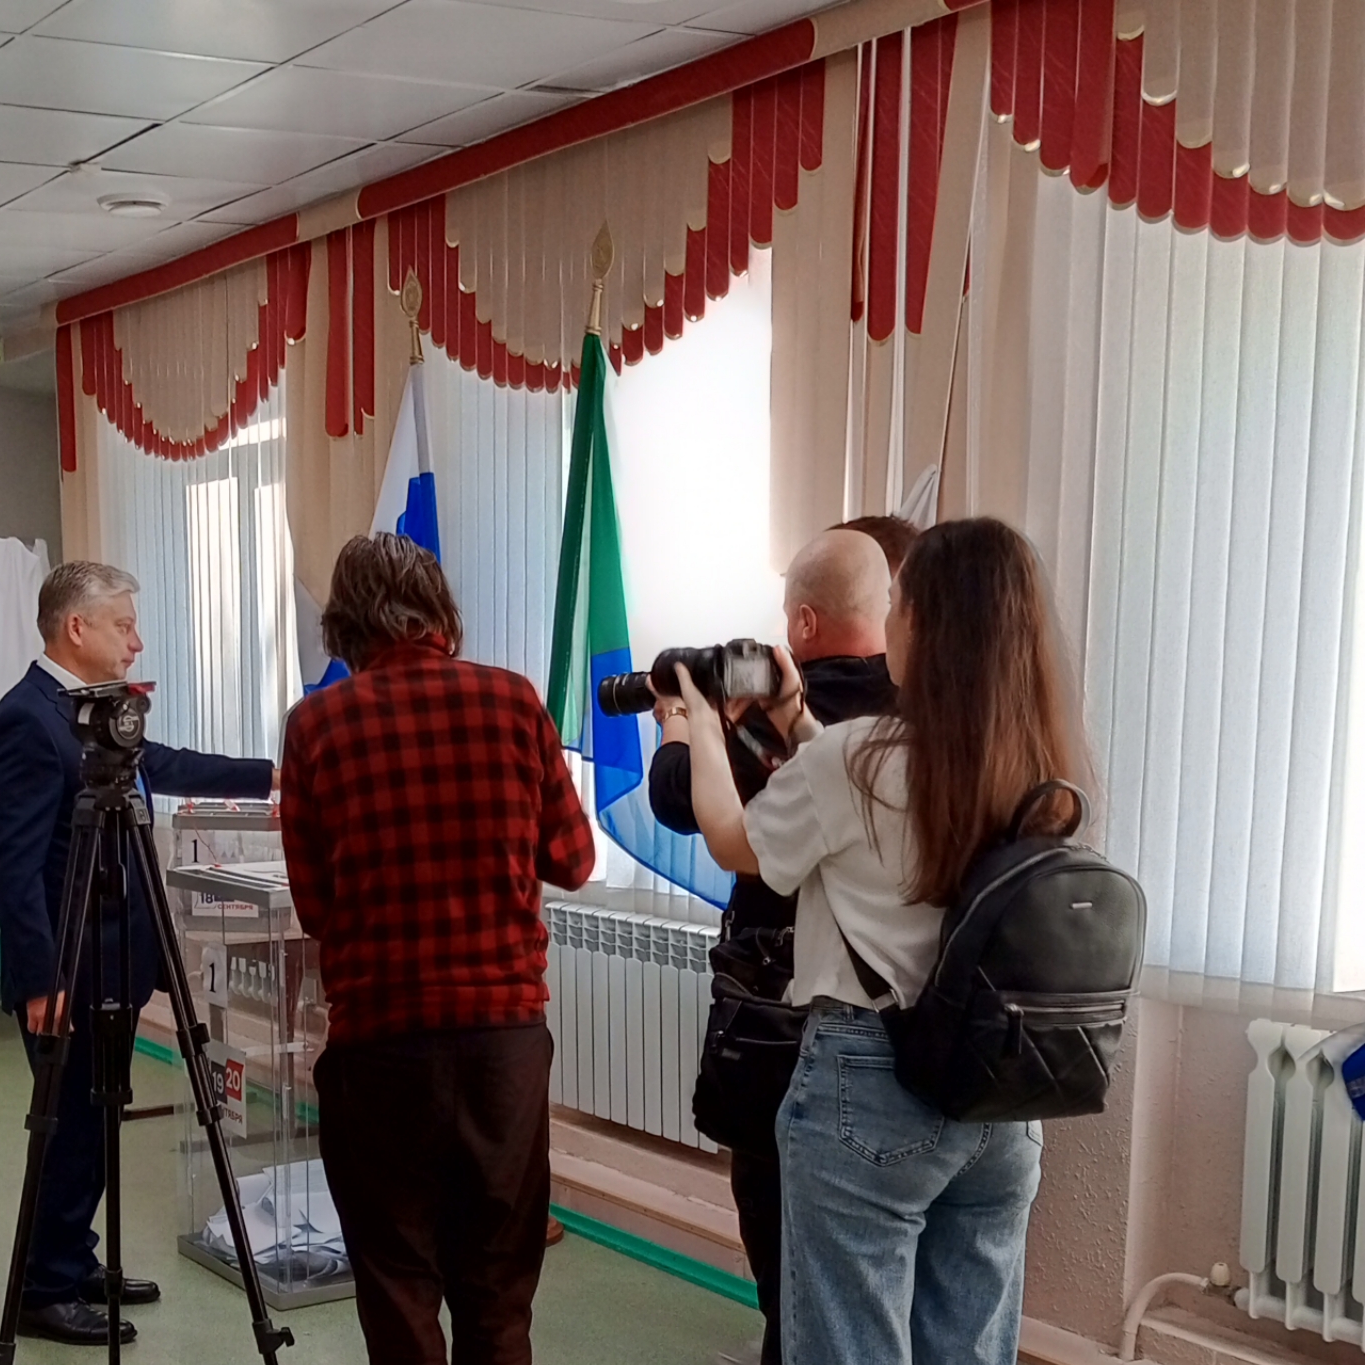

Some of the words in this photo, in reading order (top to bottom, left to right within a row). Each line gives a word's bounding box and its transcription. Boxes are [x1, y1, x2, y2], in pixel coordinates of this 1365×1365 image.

[191, 839, 200, 863] 1
[209, 962, 217, 993] 1
[225, 1066, 241, 1092] 20
